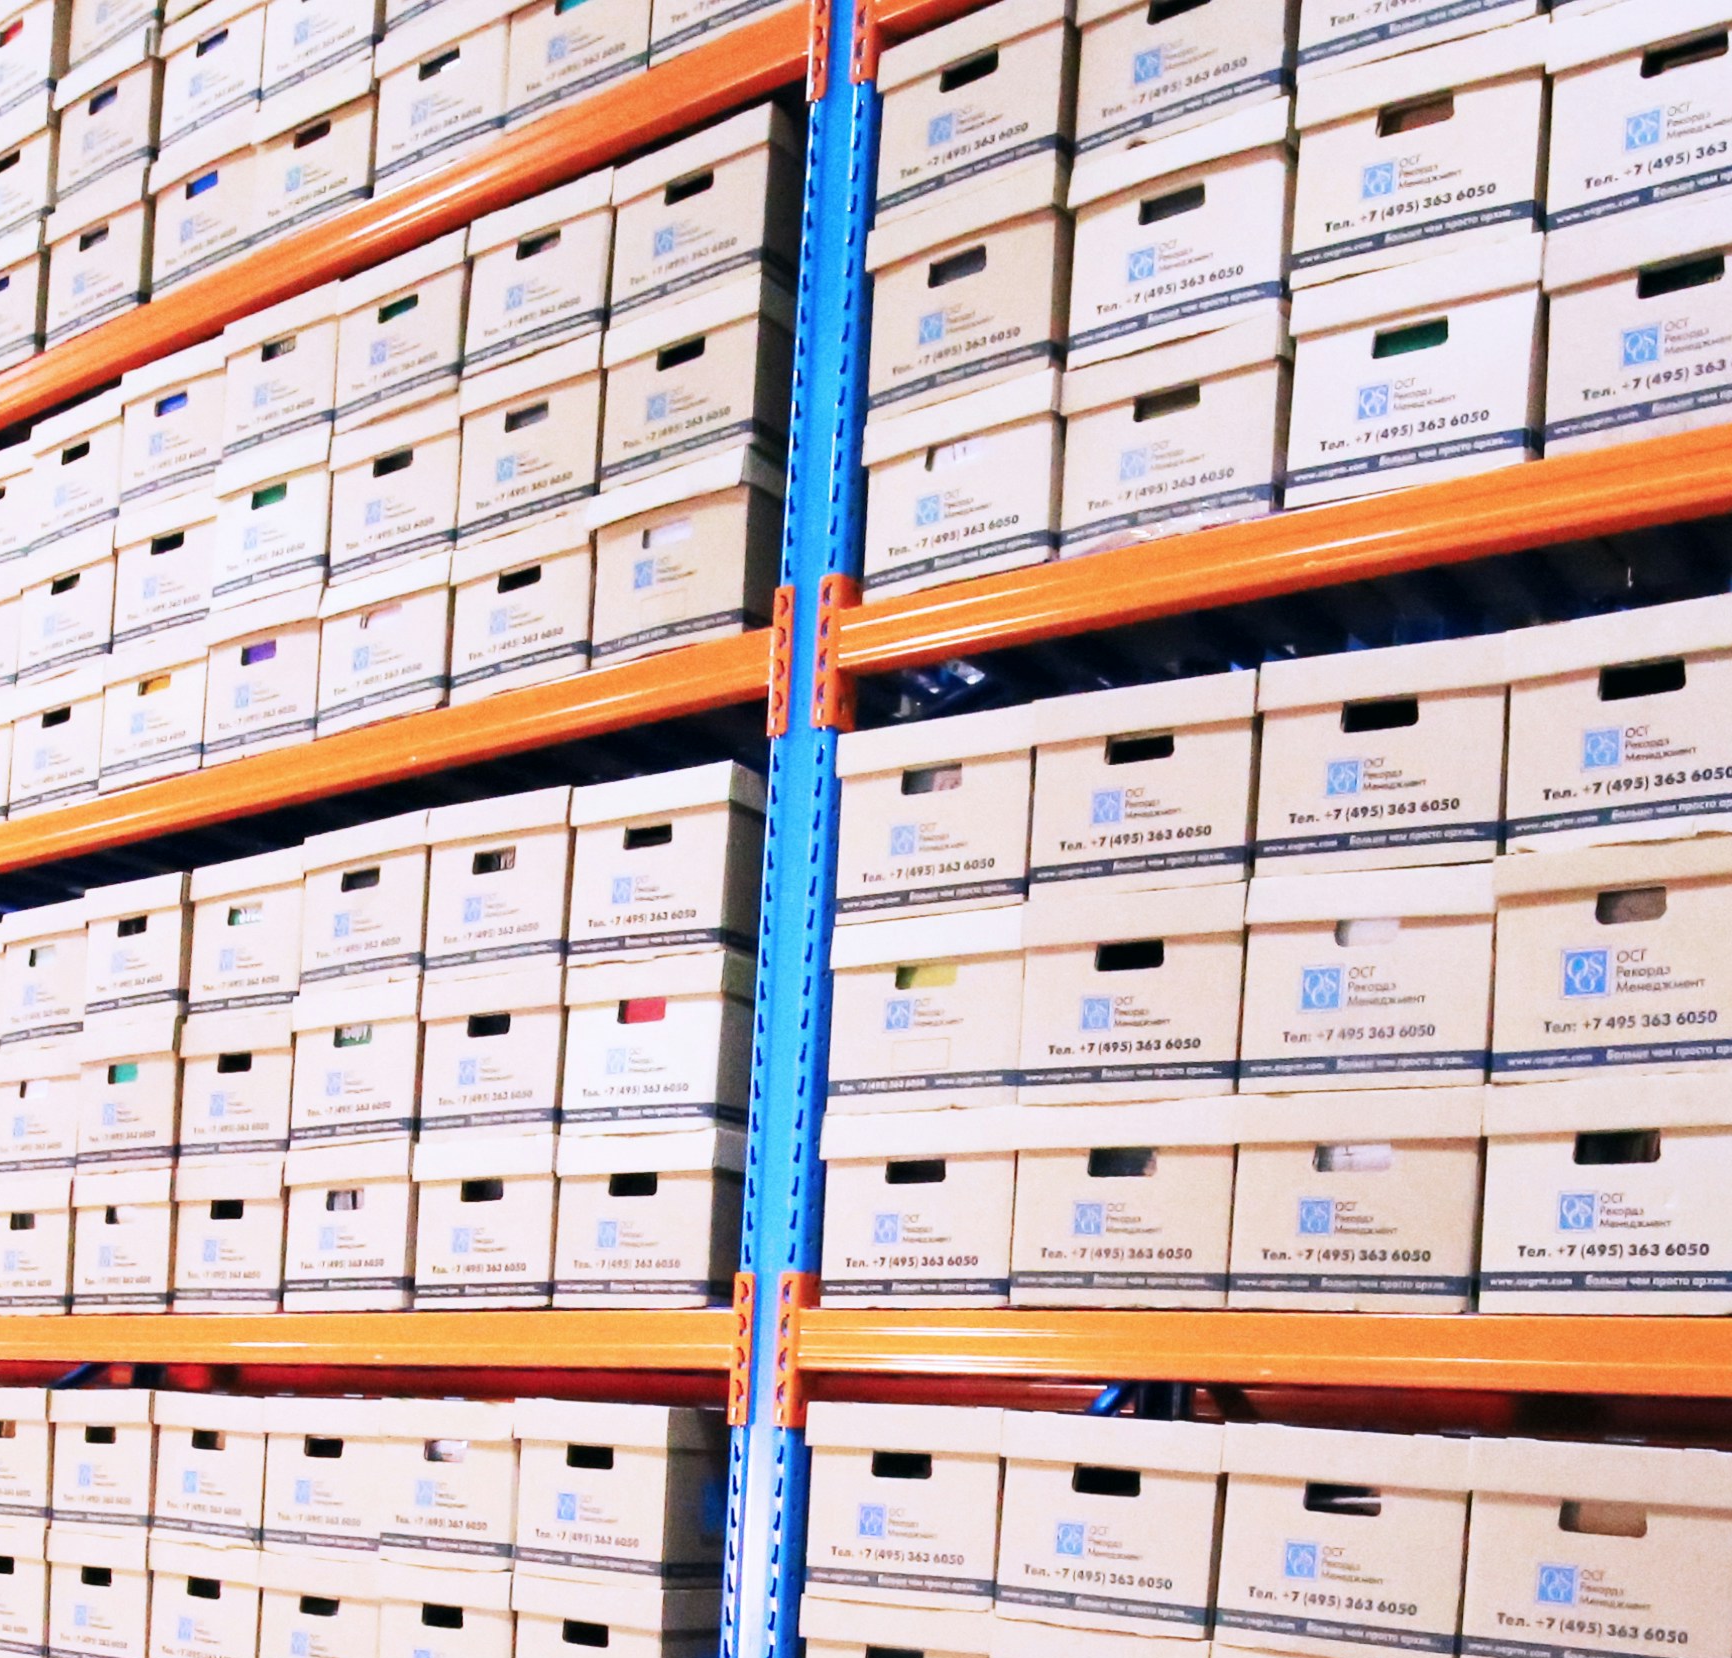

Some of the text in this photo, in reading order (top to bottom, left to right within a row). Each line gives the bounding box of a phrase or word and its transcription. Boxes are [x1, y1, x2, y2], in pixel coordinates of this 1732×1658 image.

[1096, 297, 1121, 315] Тел.
[1144, 281, 1176, 304] (495)
[1180, 272, 1205, 292] 363
[1208, 261, 1243, 283] 6050
[1288, 796, 1460, 825] Тел. +7 (495) 363 6050
[862, 870, 885, 884] Тел.
[905, 863, 935, 880] (495)
[938, 860, 960, 875] 363
[963, 856, 995, 871] 6050
[831, 1545, 854, 1557] Тел.
[874, 1548, 904, 1563] (495)
[907, 1551, 929, 1562] 363
[933, 1553, 964, 1565] 6050
[1496, 1611, 1688, 1644] Тел. +7 (495) 363 6050
